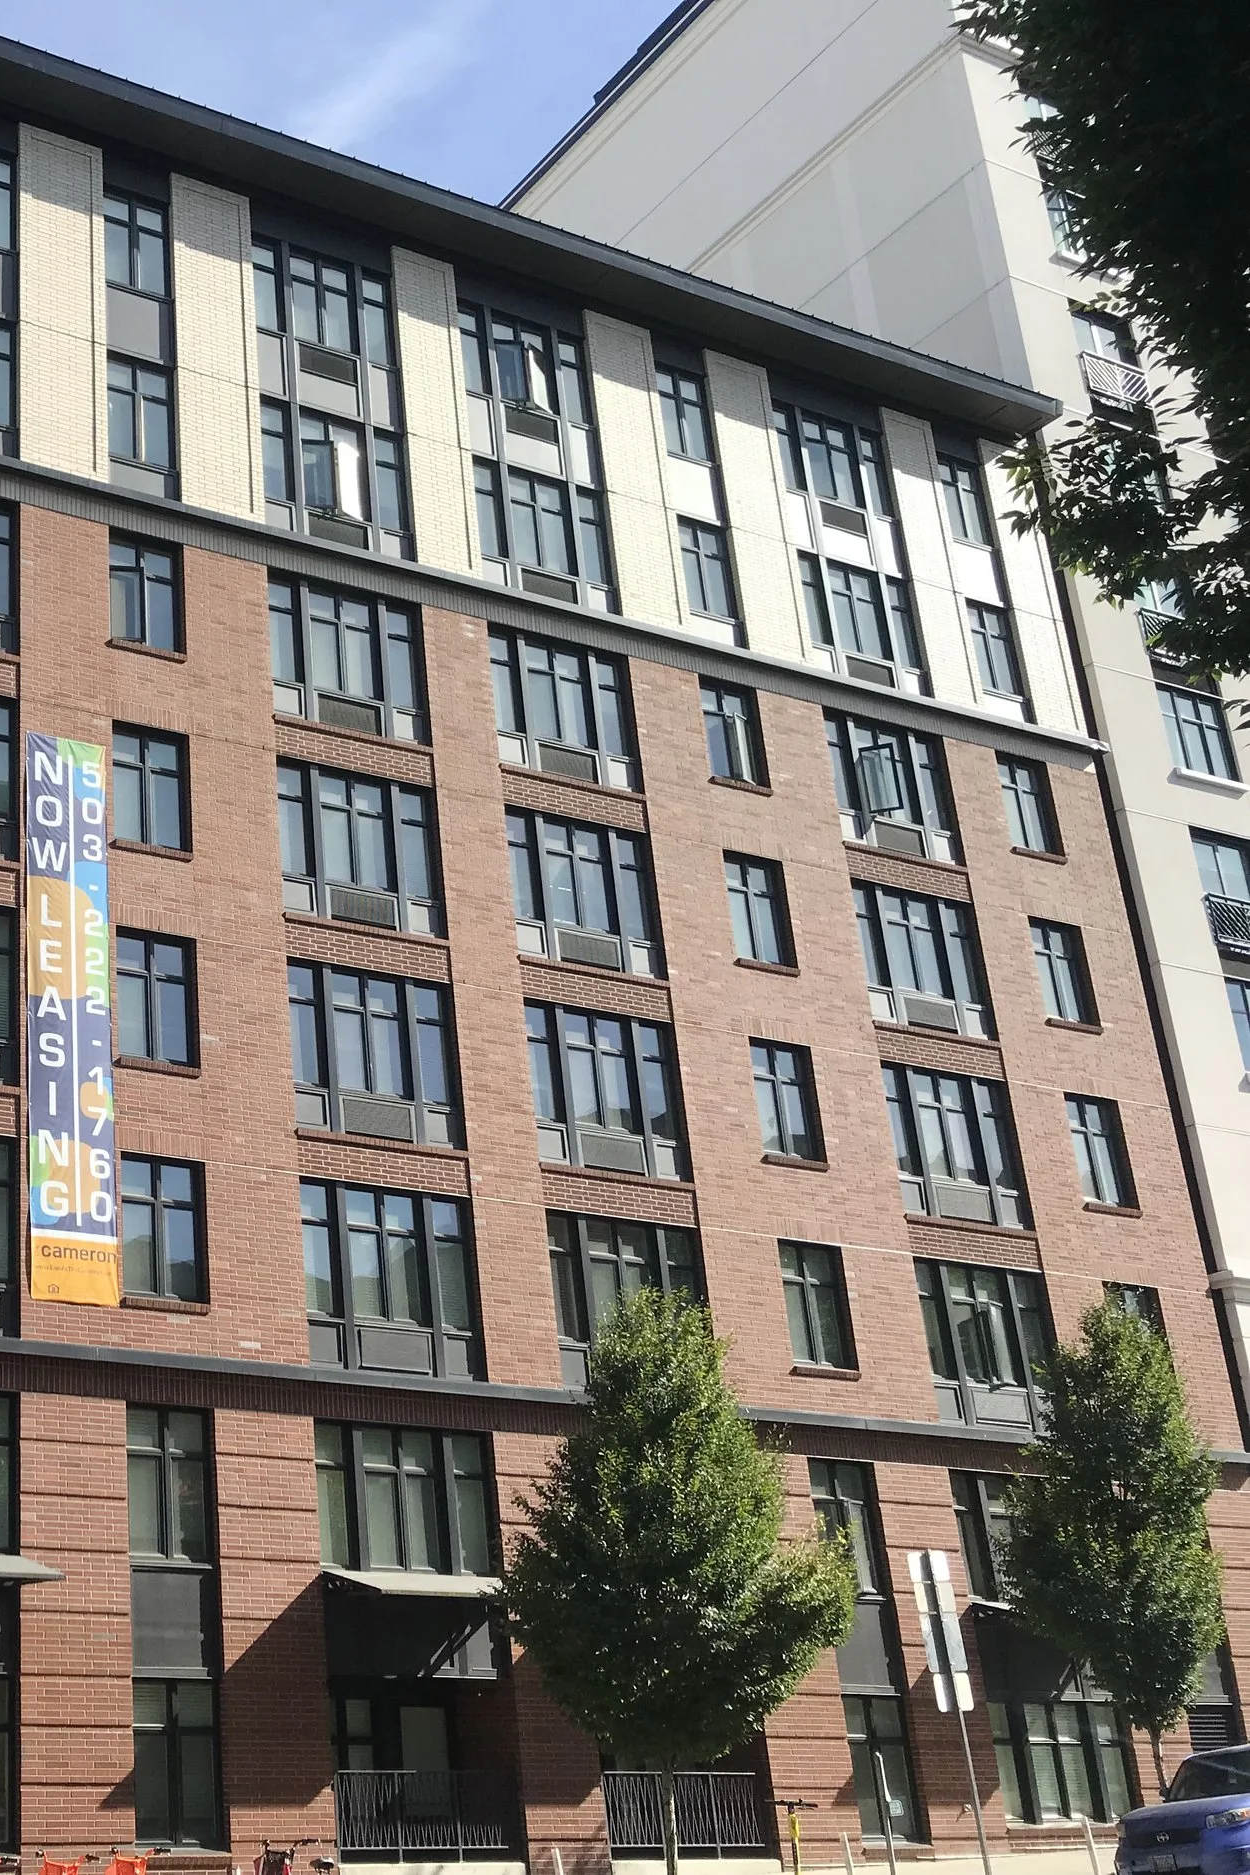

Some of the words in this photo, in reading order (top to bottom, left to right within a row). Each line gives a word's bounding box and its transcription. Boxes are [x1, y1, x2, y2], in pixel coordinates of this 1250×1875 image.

[32, 750, 67, 873] NOW
[36, 893, 70, 1218] LEASING
[81, 760, 113, 1223] 503-222-1760
[41, 1244, 117, 1265] cameron
